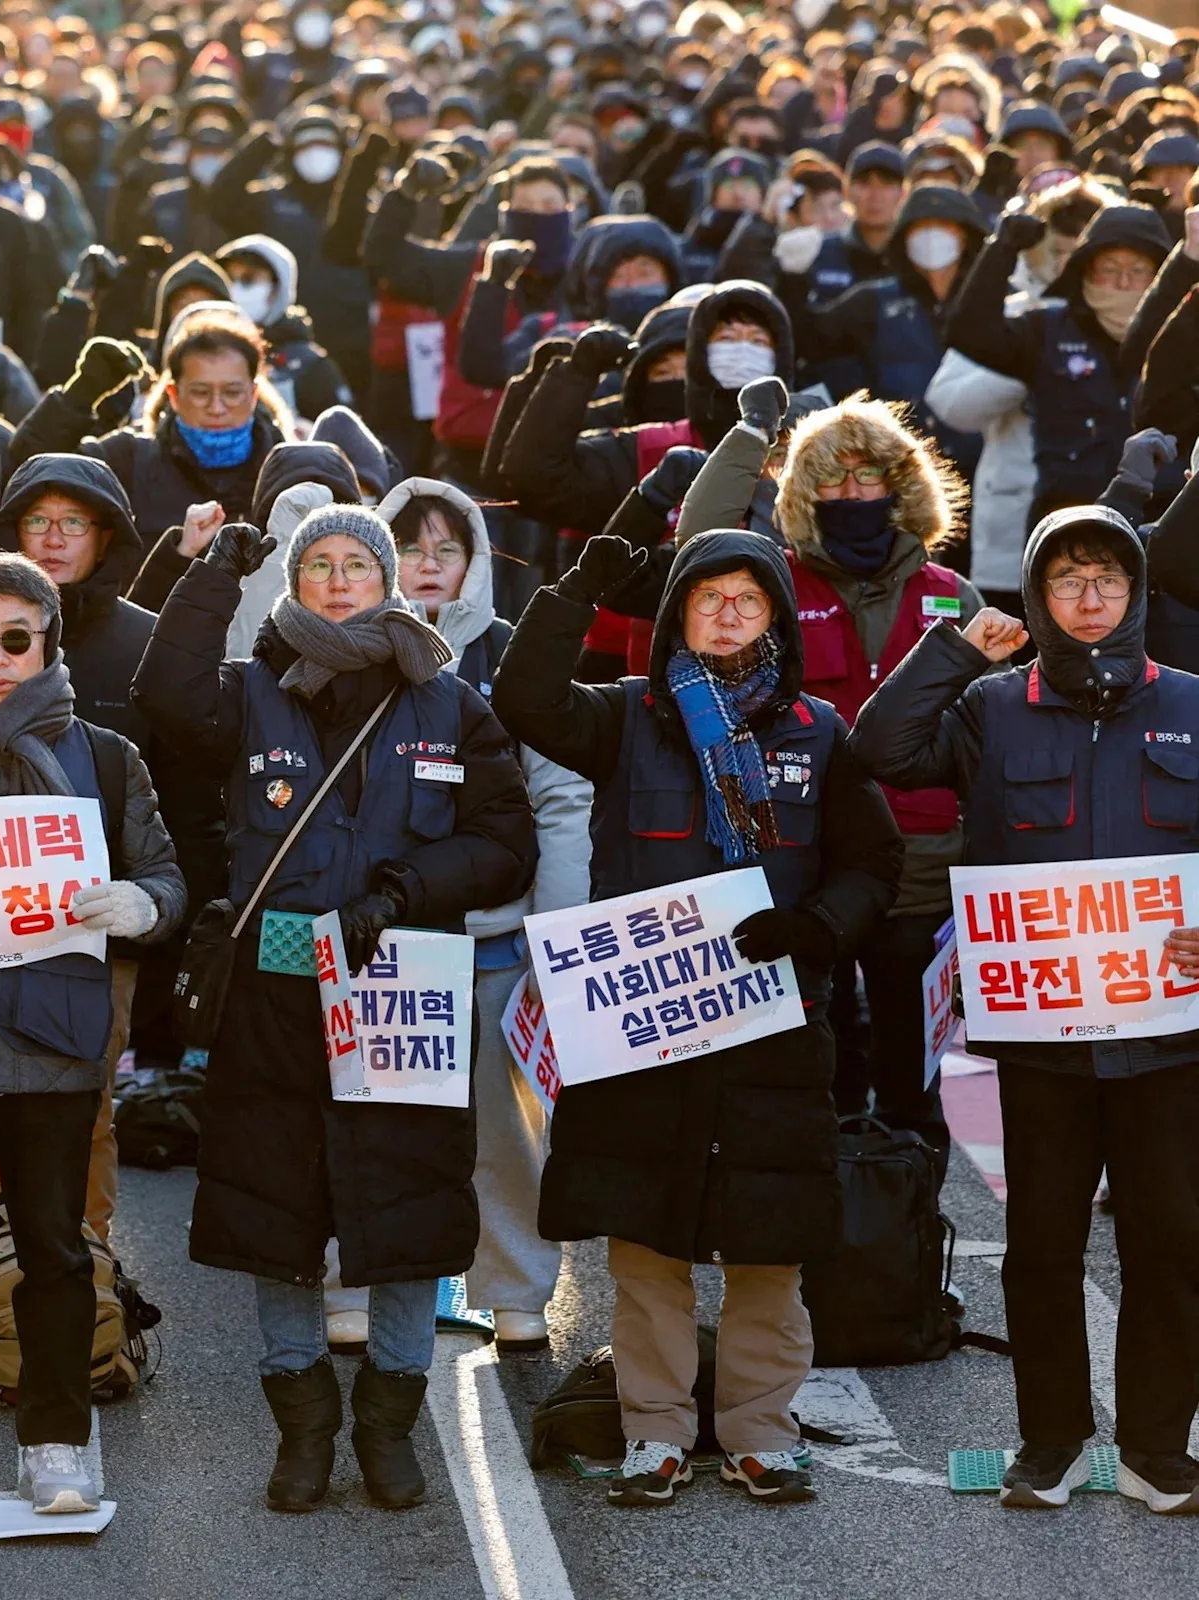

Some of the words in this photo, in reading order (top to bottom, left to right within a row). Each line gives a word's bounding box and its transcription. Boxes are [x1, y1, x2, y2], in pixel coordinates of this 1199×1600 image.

[776, 752, 811, 764] 민주노총
[1155, 732, 1191, 744] 민주노총
[964, 874, 1185, 944] 내란세력
[543, 921, 620, 974] 노동
[626, 894, 705, 949] 중심
[349, 943, 399, 979] 심
[584, 935, 737, 1011] 사회대개
[979, 956, 1083, 1012] 완전
[351, 989, 455, 1026] 대개혁
[509, 985, 545, 1065] 내란
[621, 964, 785, 1049] 실현하자!
[1076, 1024, 1116, 1036] 민주노총
[322, 999, 357, 1063] 산
[359, 1034, 456, 1072] 하자!
[672, 1039, 711, 1056] 민주노총
